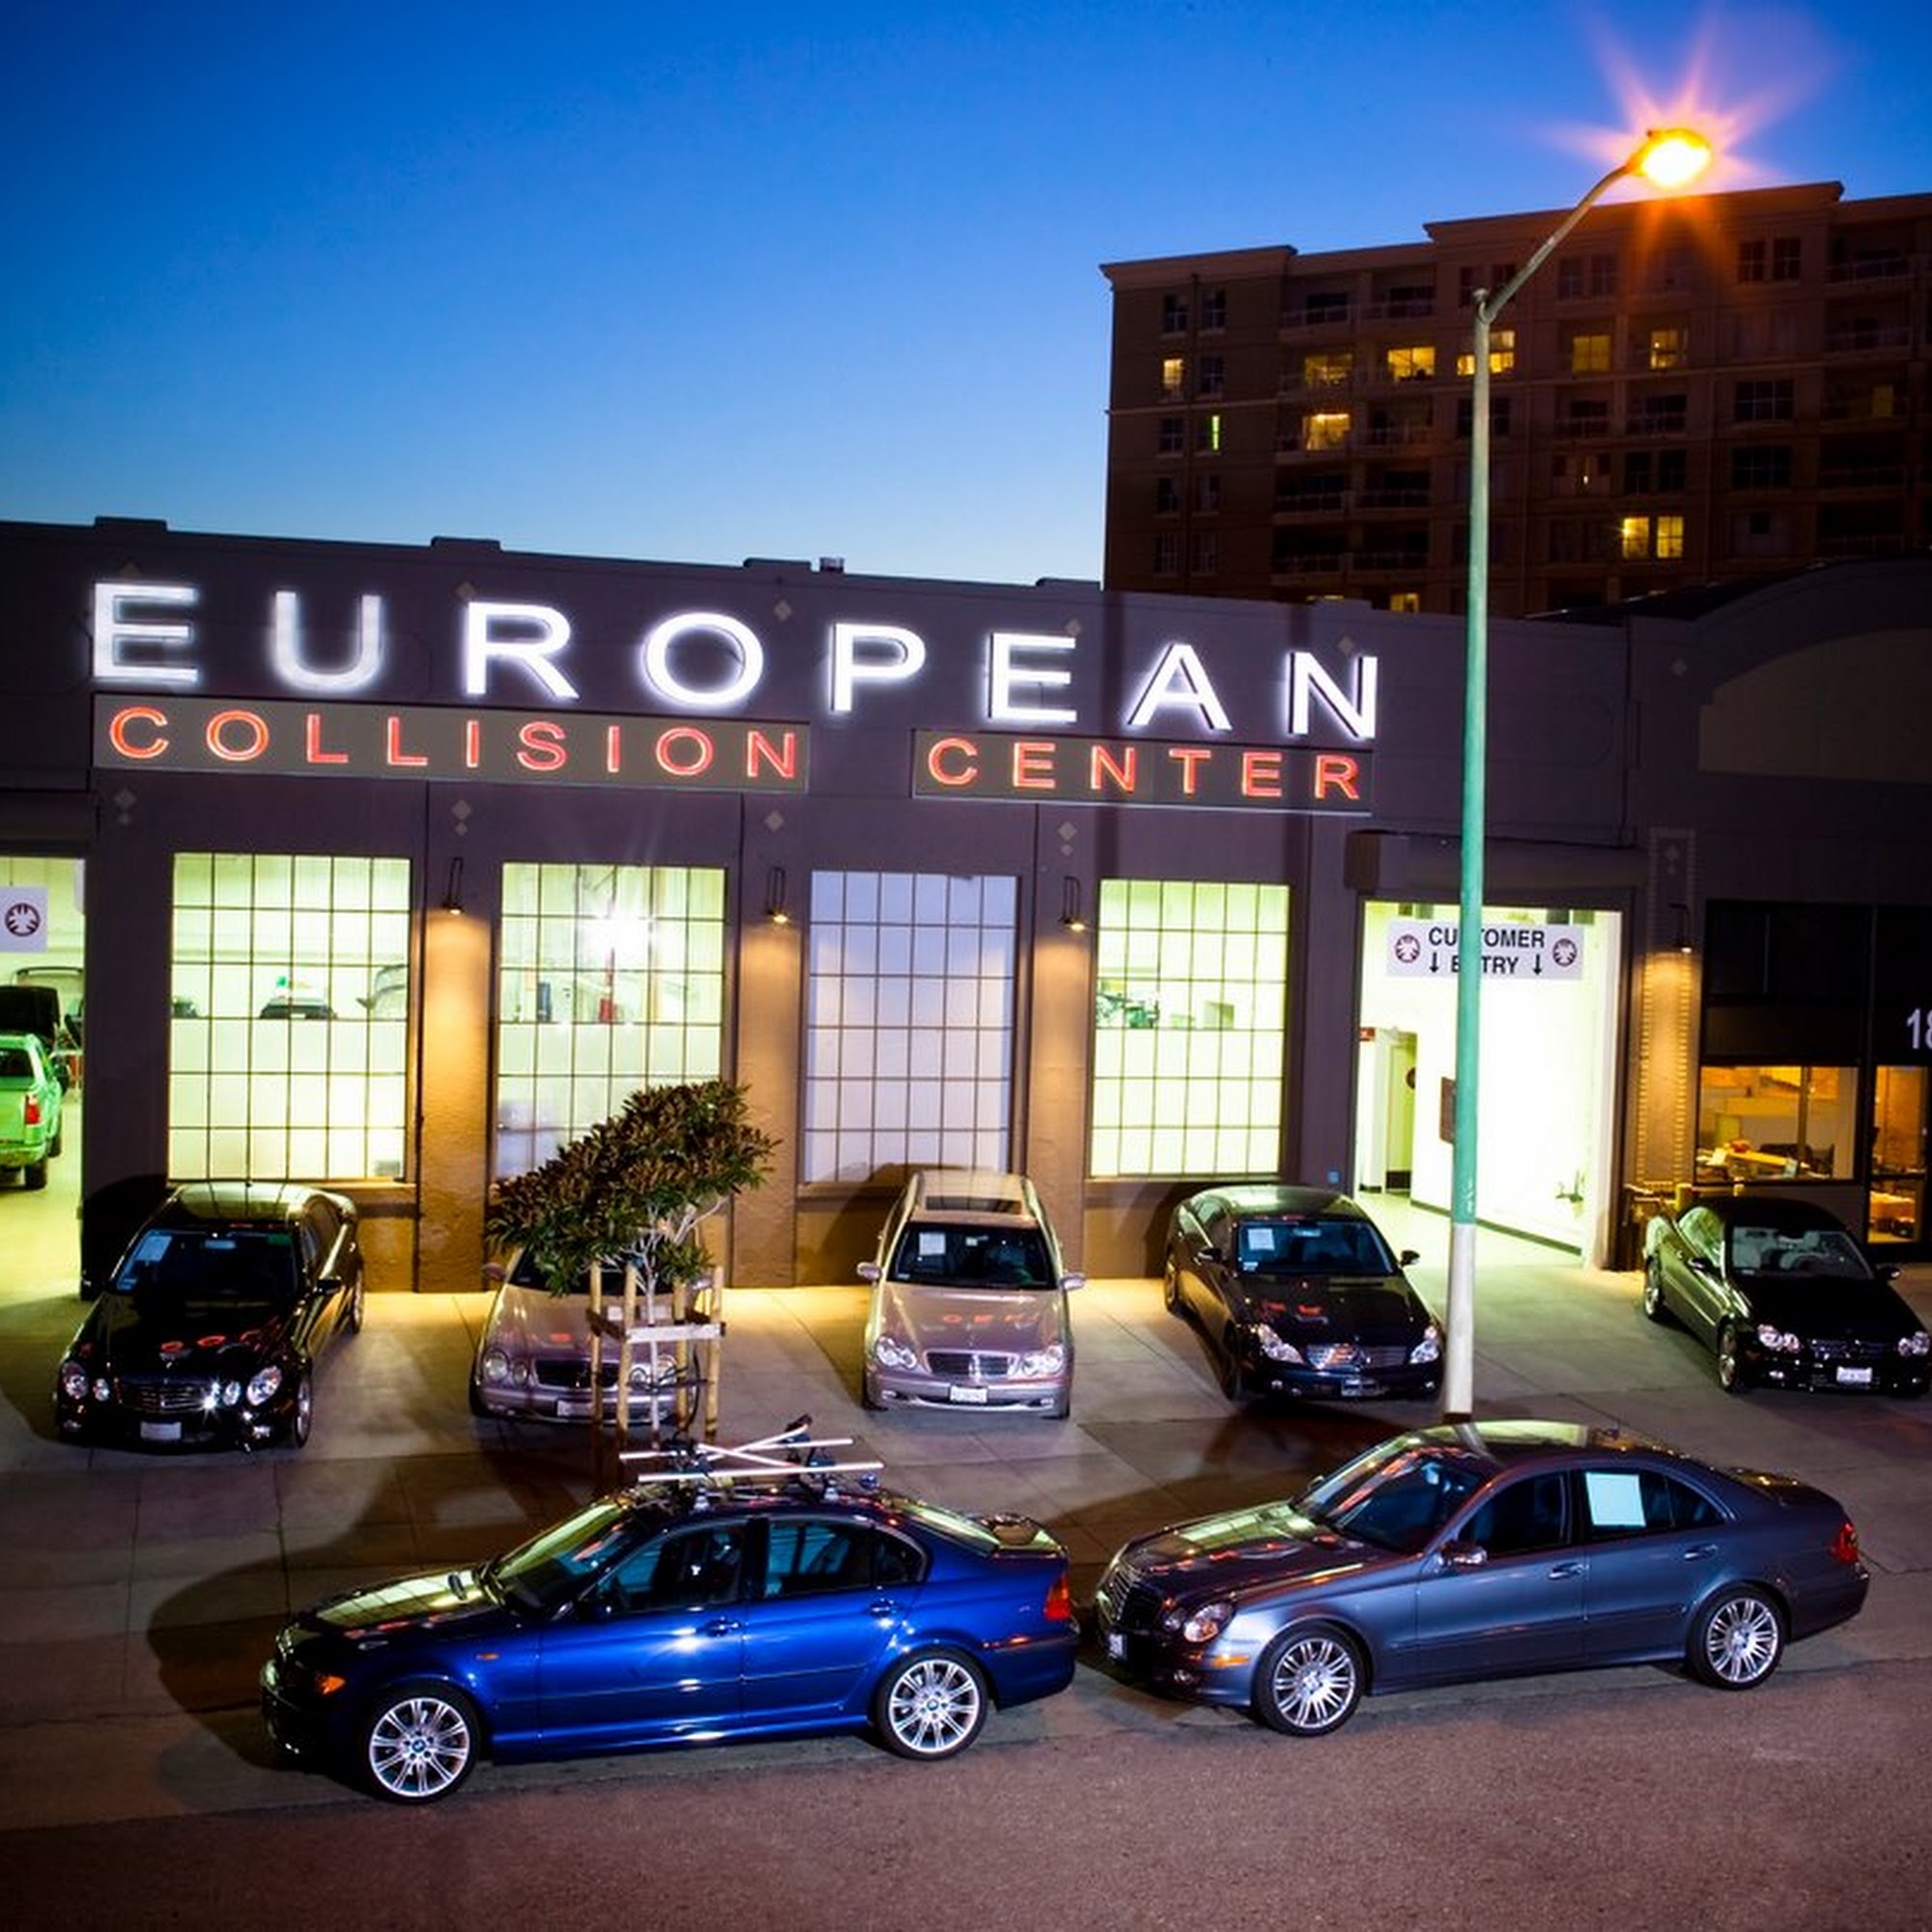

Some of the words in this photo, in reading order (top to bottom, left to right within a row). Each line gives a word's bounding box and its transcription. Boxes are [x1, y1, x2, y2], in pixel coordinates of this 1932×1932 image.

[93, 582, 1378, 740] EUROPEAN
[108, 705, 797, 779] COLLISION
[927, 737, 1360, 801] CENTER
[1428, 926, 1545, 948] CUOMER
[1451, 954, 1519, 974] ETRY
